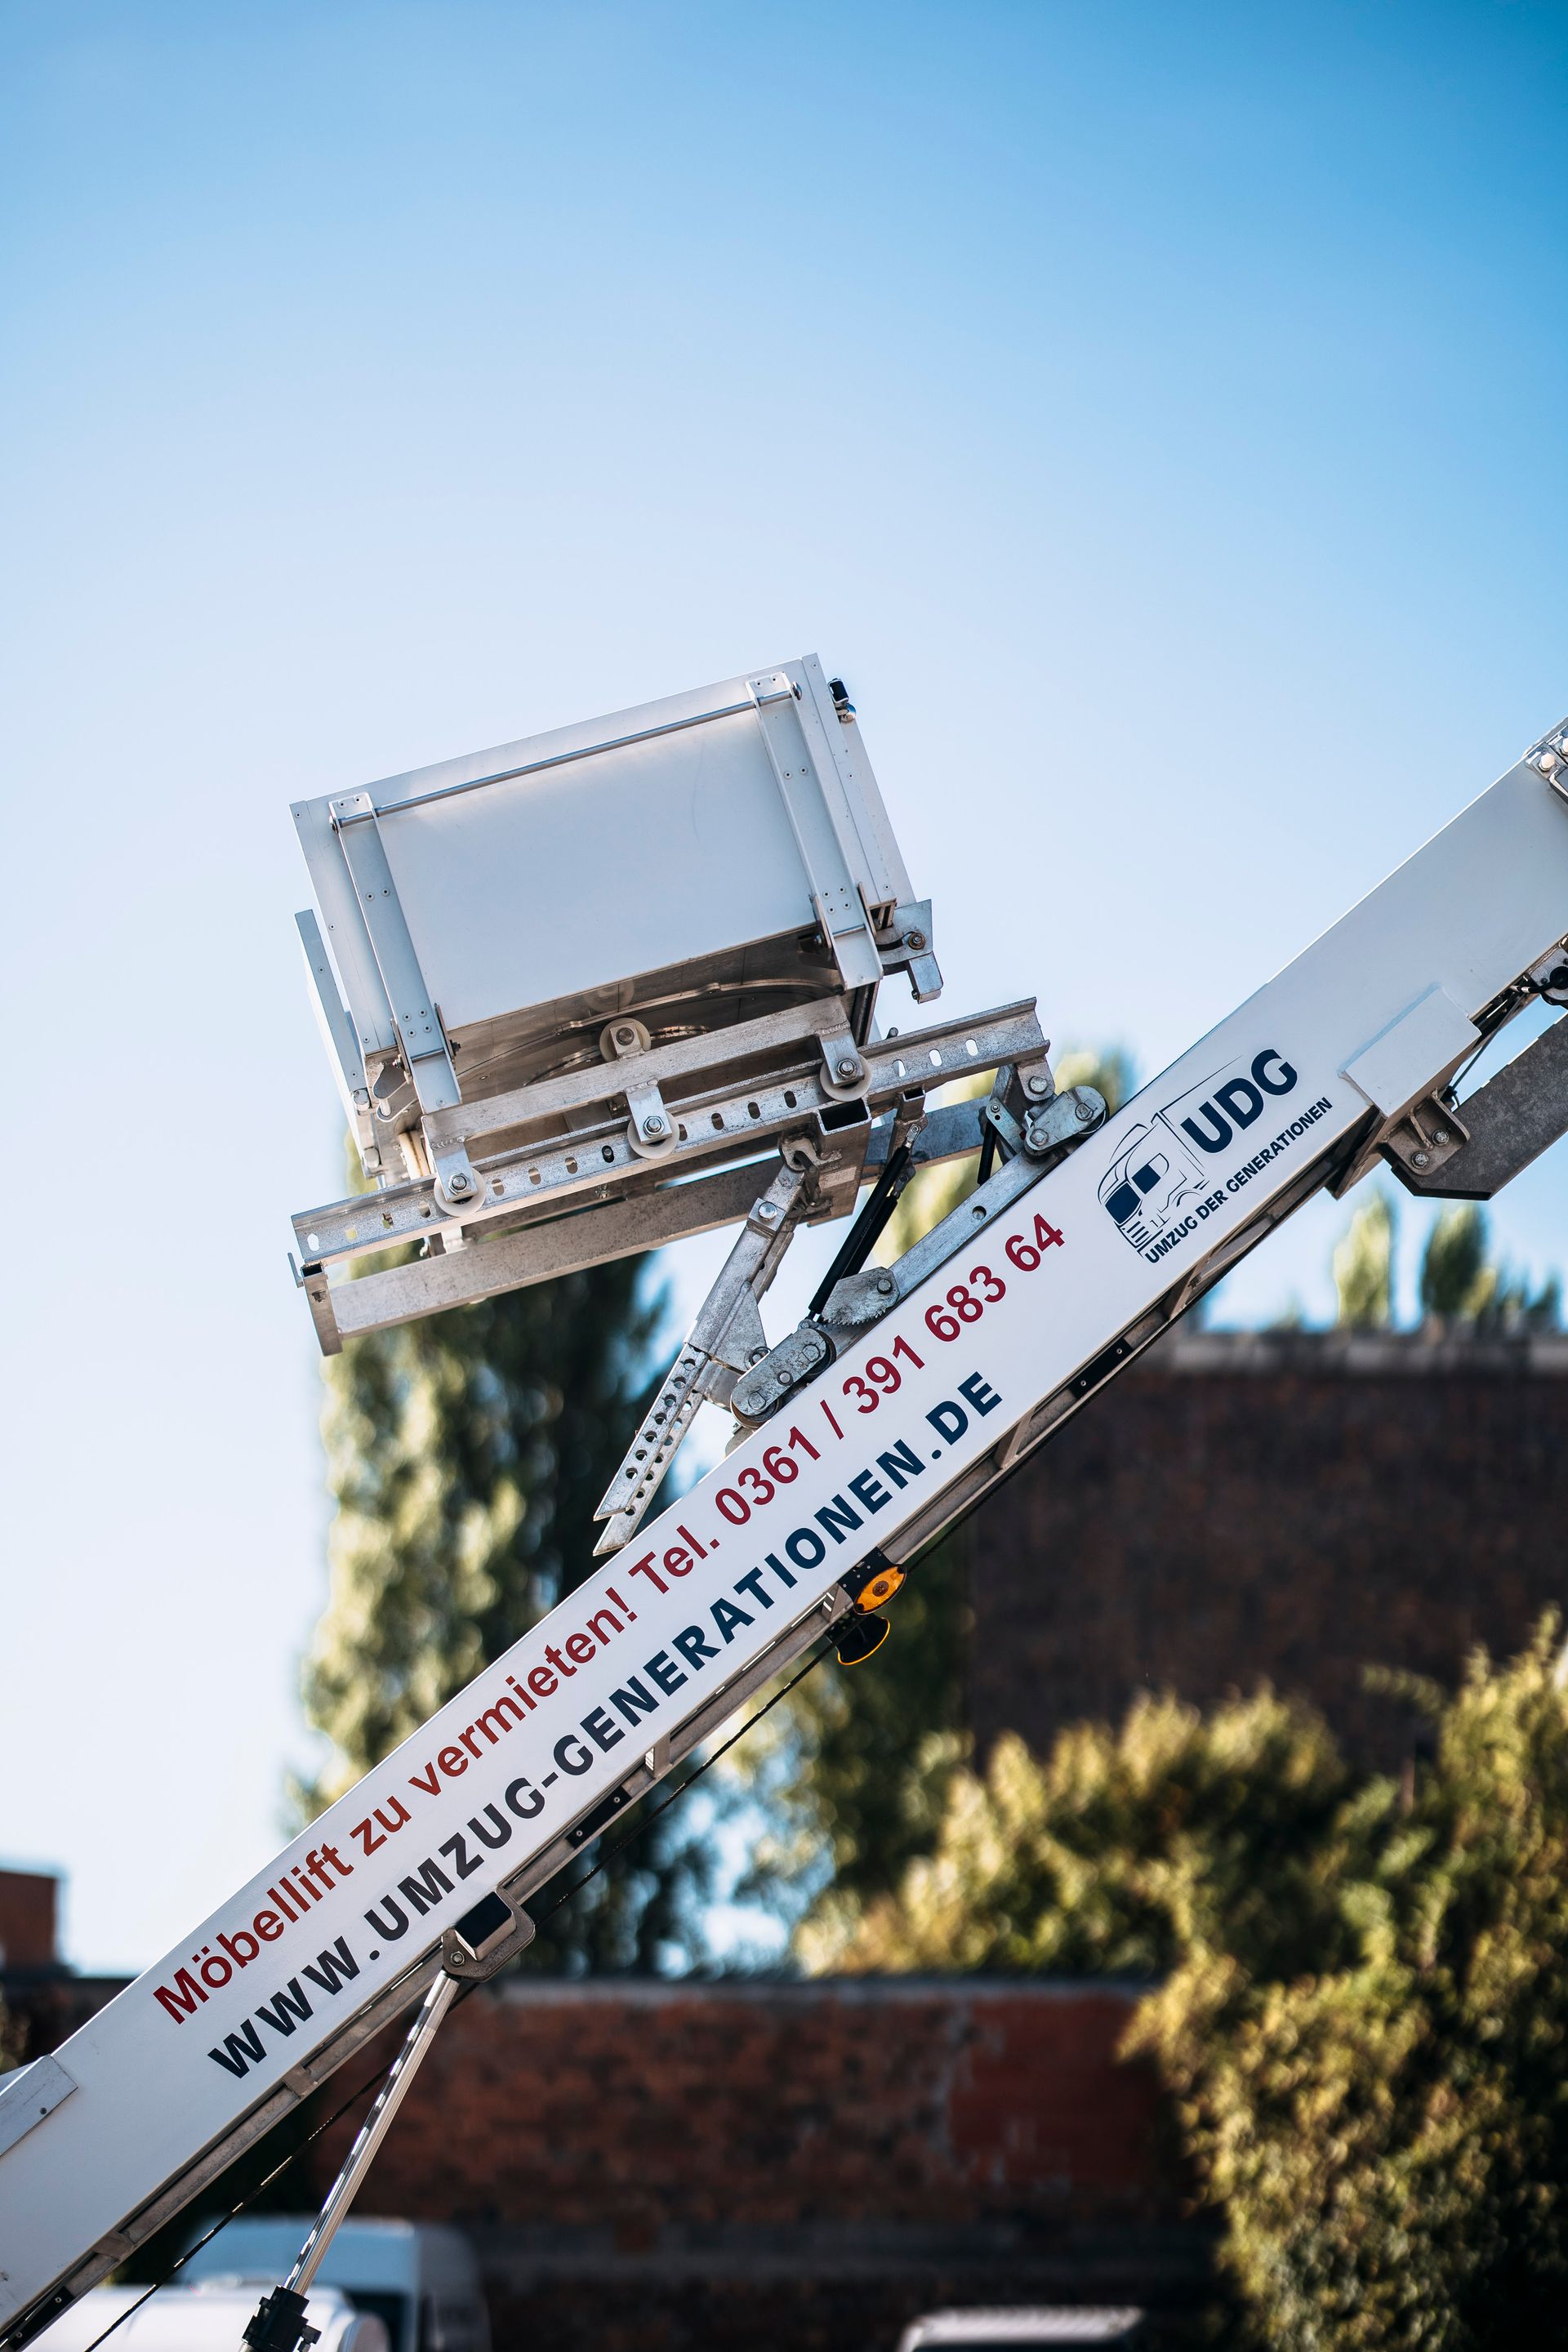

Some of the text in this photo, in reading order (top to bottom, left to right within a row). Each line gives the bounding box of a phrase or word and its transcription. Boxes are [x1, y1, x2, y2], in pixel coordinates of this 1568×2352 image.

[1144, 1097, 1334, 1263] UMZUG DER GENERATIONEN
[1179, 1049, 1298, 1154] UDG
[152, 1213, 1065, 2025] Möbellift zu vermieten! Tel. 0361 / 391 683 64
[207, 1371, 1003, 2079] WWW.UMZUG-GENERATIONEN.DE
